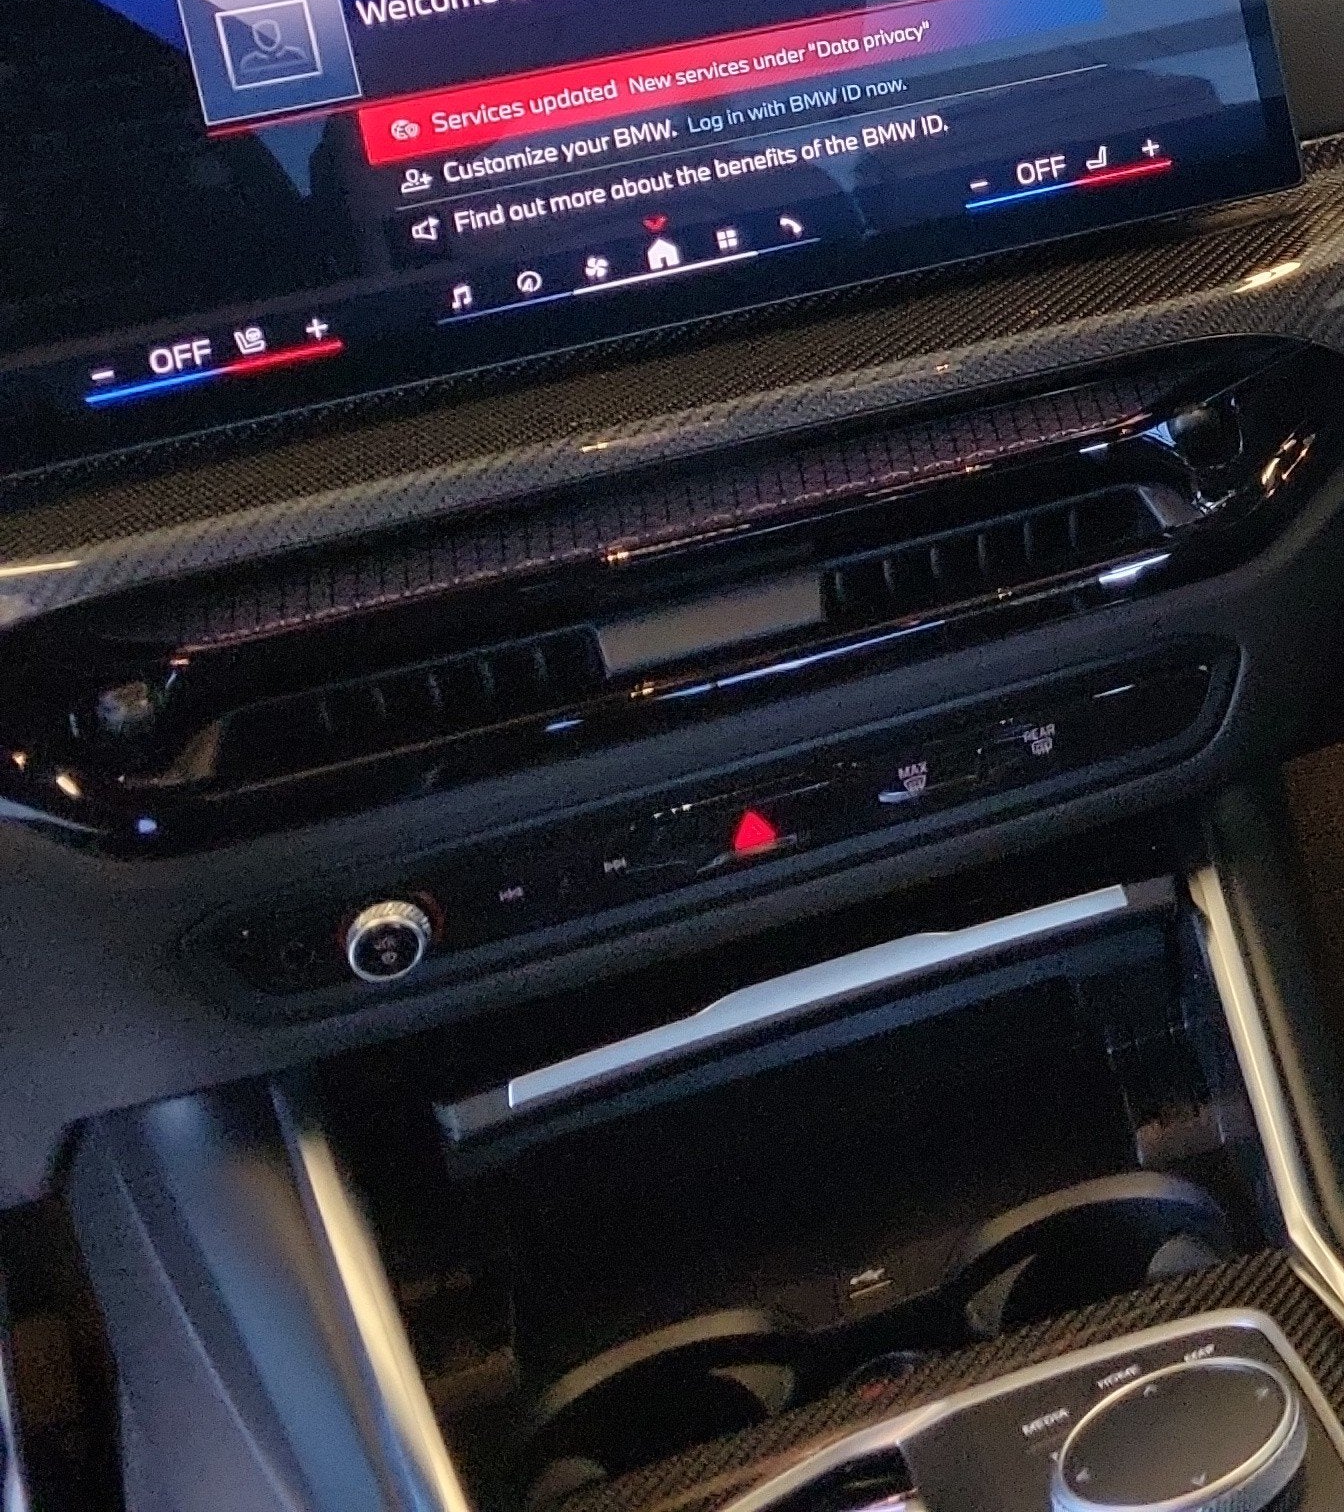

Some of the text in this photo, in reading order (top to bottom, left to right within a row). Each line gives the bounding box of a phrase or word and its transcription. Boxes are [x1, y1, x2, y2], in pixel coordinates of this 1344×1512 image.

[431, 100, 525, 133] Services
[529, 79, 618, 115] updated
[628, 75, 672, 94] New
[675, 58, 750, 85] services
[753, 46, 807, 70] under
[863, 19, 930, 49] privacy"
[443, 78, 907, 183] Customize your BMW. Log in with BMW ID now.
[453, 114, 949, 233] Find out more about the benefits of the BMW ID.
[1016, 155, 1066, 185] OFF
[149, 338, 211, 374] OFF
[1023, 723, 1056, 743] REAR
[898, 761, 928, 781] MAX
